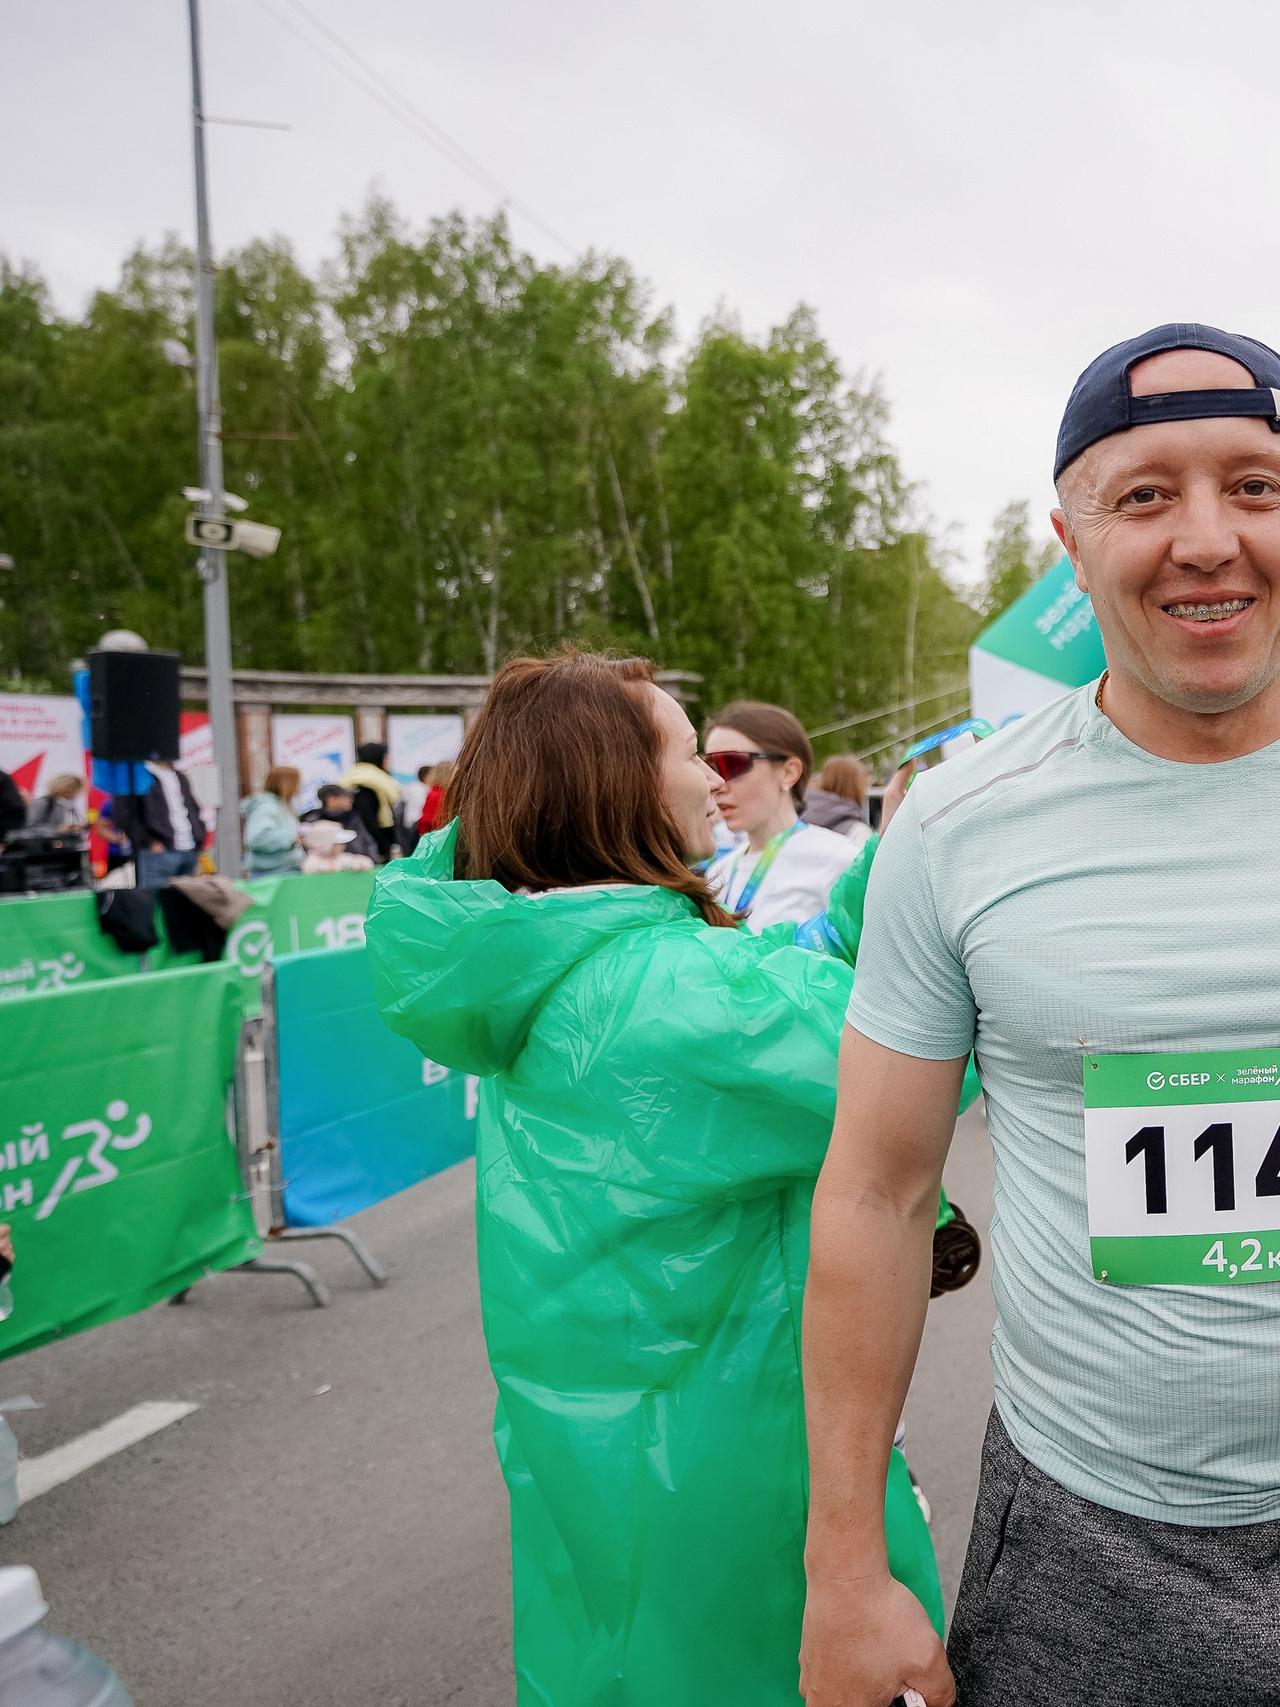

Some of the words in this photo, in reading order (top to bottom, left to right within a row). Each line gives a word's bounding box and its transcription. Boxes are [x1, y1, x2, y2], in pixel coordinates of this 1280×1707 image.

[1236, 1064, 1279, 1076] зелёный
[1168, 1072, 1211, 1087] СБЕР
[1231, 1073, 1276, 1086] марафон
